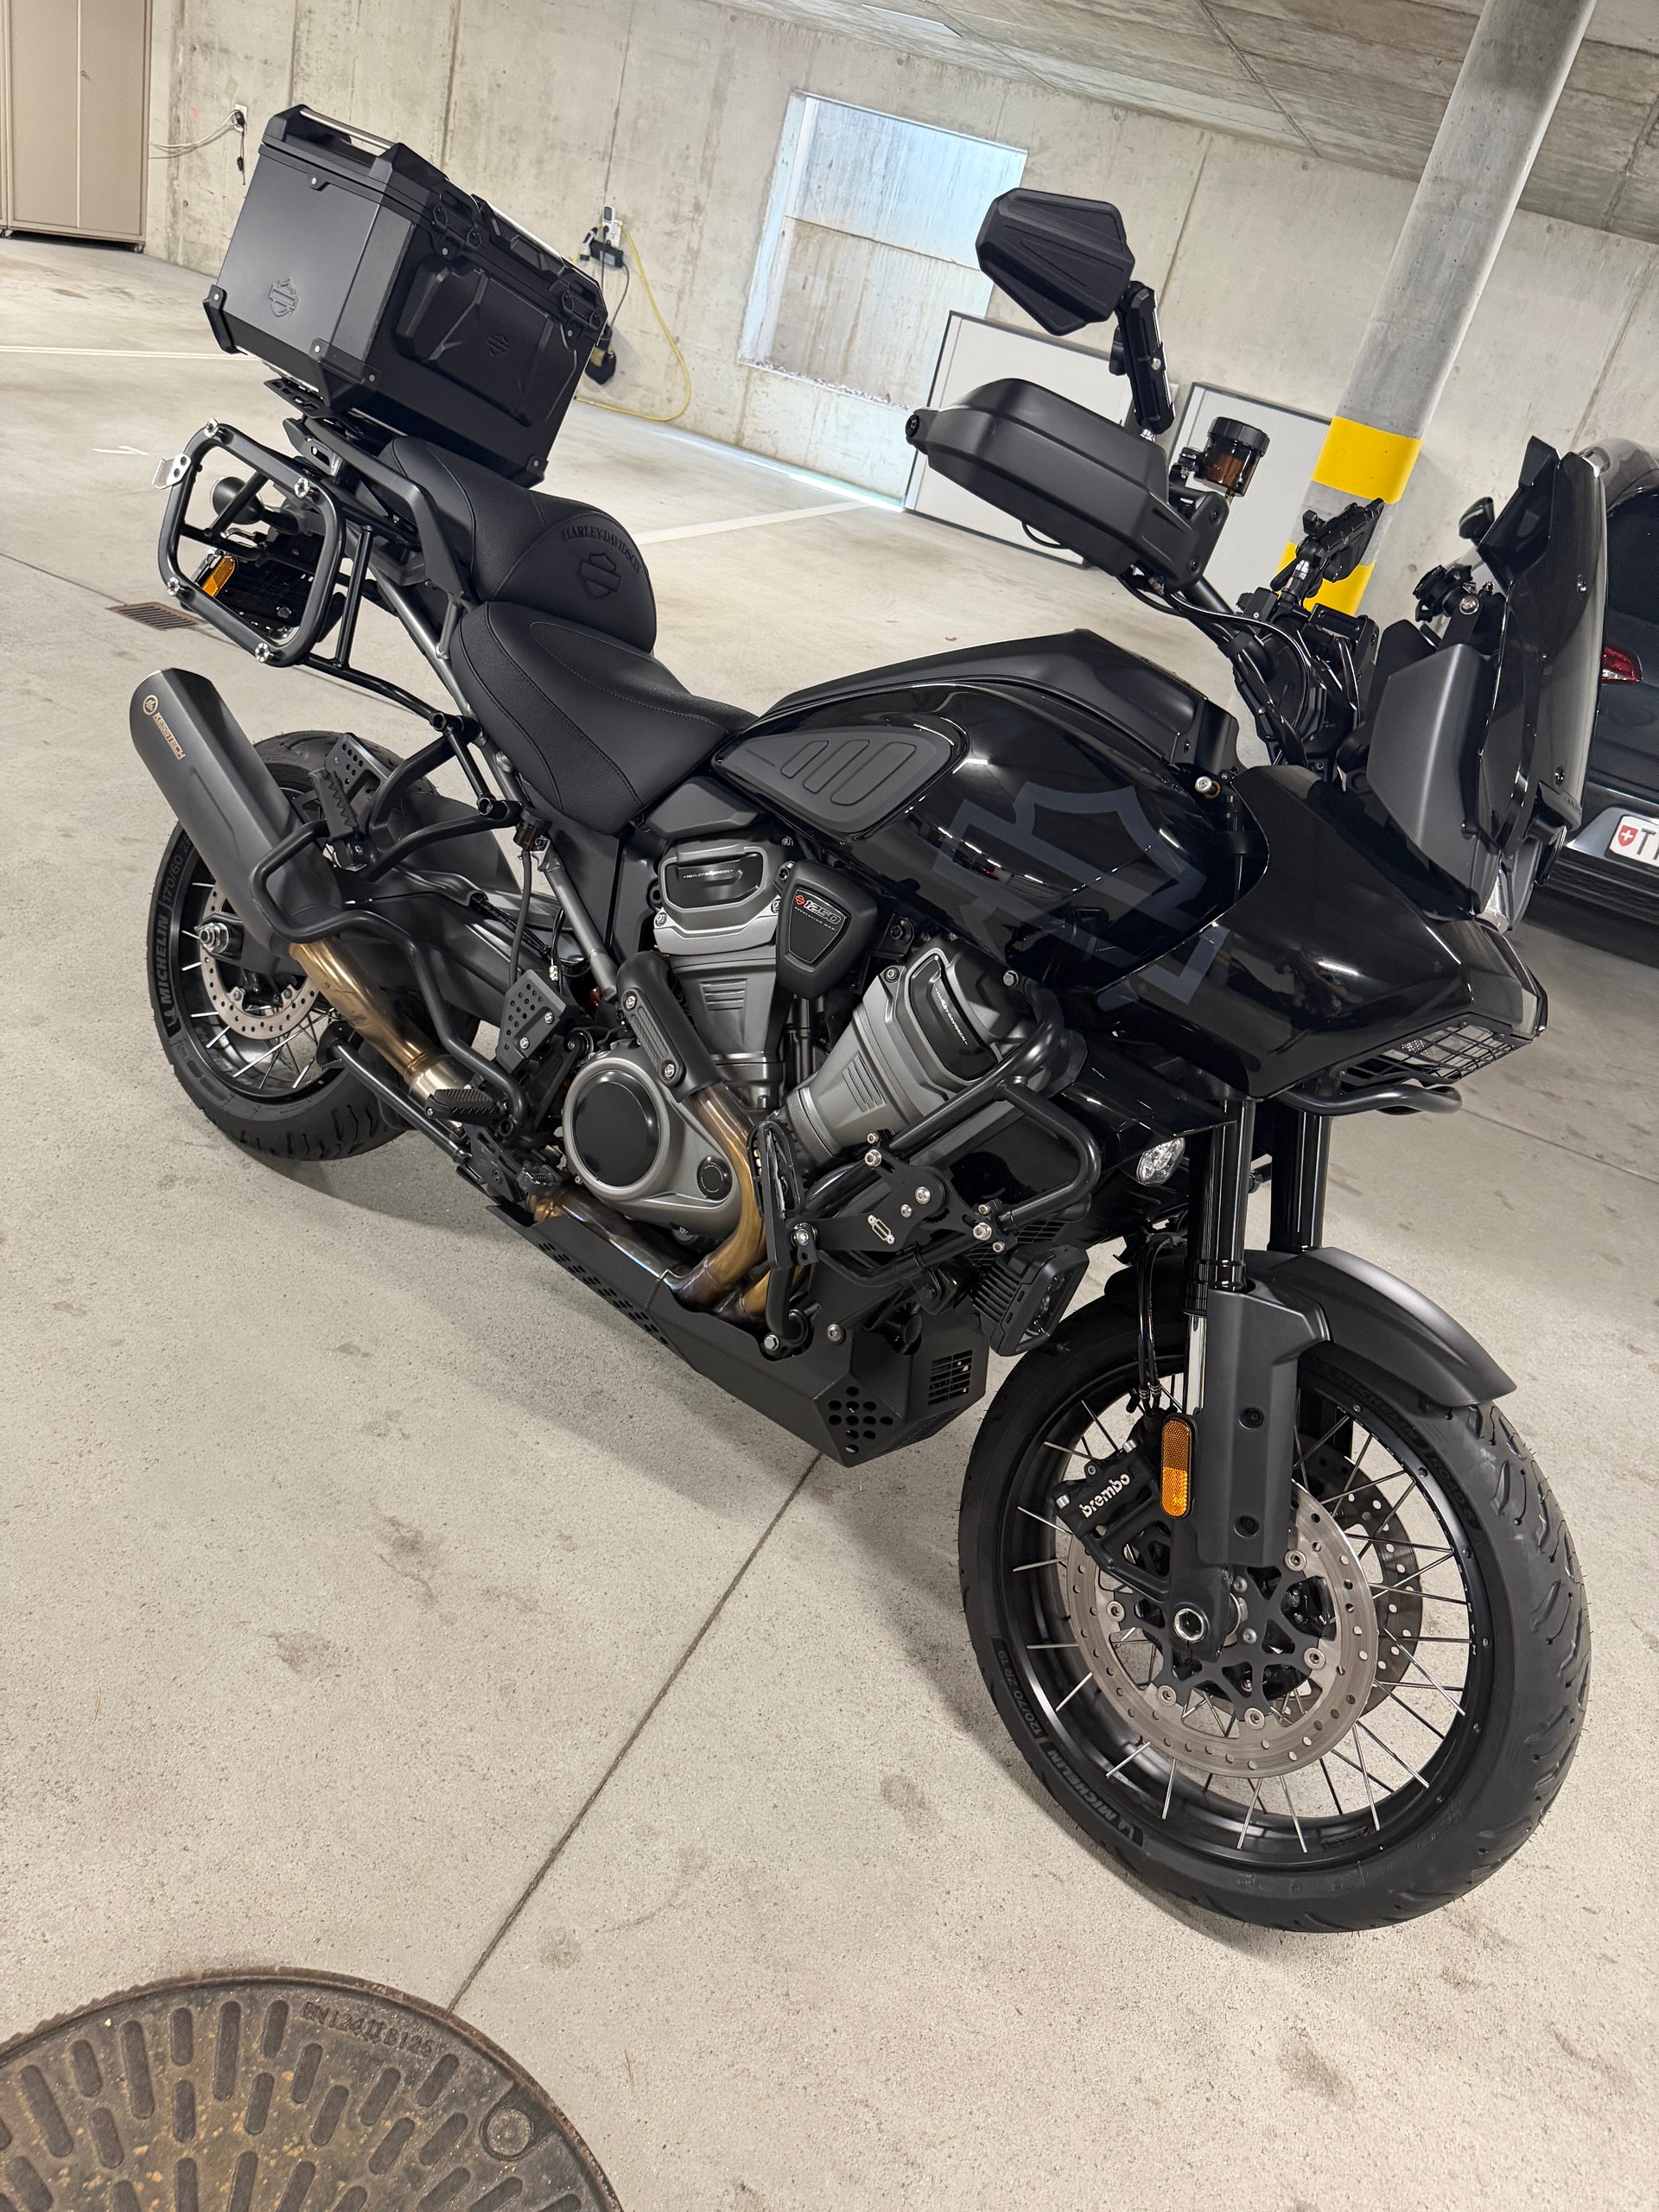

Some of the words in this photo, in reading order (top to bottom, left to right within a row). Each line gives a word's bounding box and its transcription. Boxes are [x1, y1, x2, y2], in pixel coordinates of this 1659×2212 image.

[563, 525, 642, 575] HARLEY-DAVIDSON
[162, 854, 183, 902] 170/60
[803, 899, 842, 925] 1250
[155, 912, 173, 1006] MICHELIN
[1078, 1473, 1131, 1518] brembo
[997, 1649, 1007, 1666] 19
[1006, 1669, 1020, 1688] ZR
[1013, 1689, 1042, 1736] 120/70
[1047, 1750, 1121, 1820] MICHELIN
